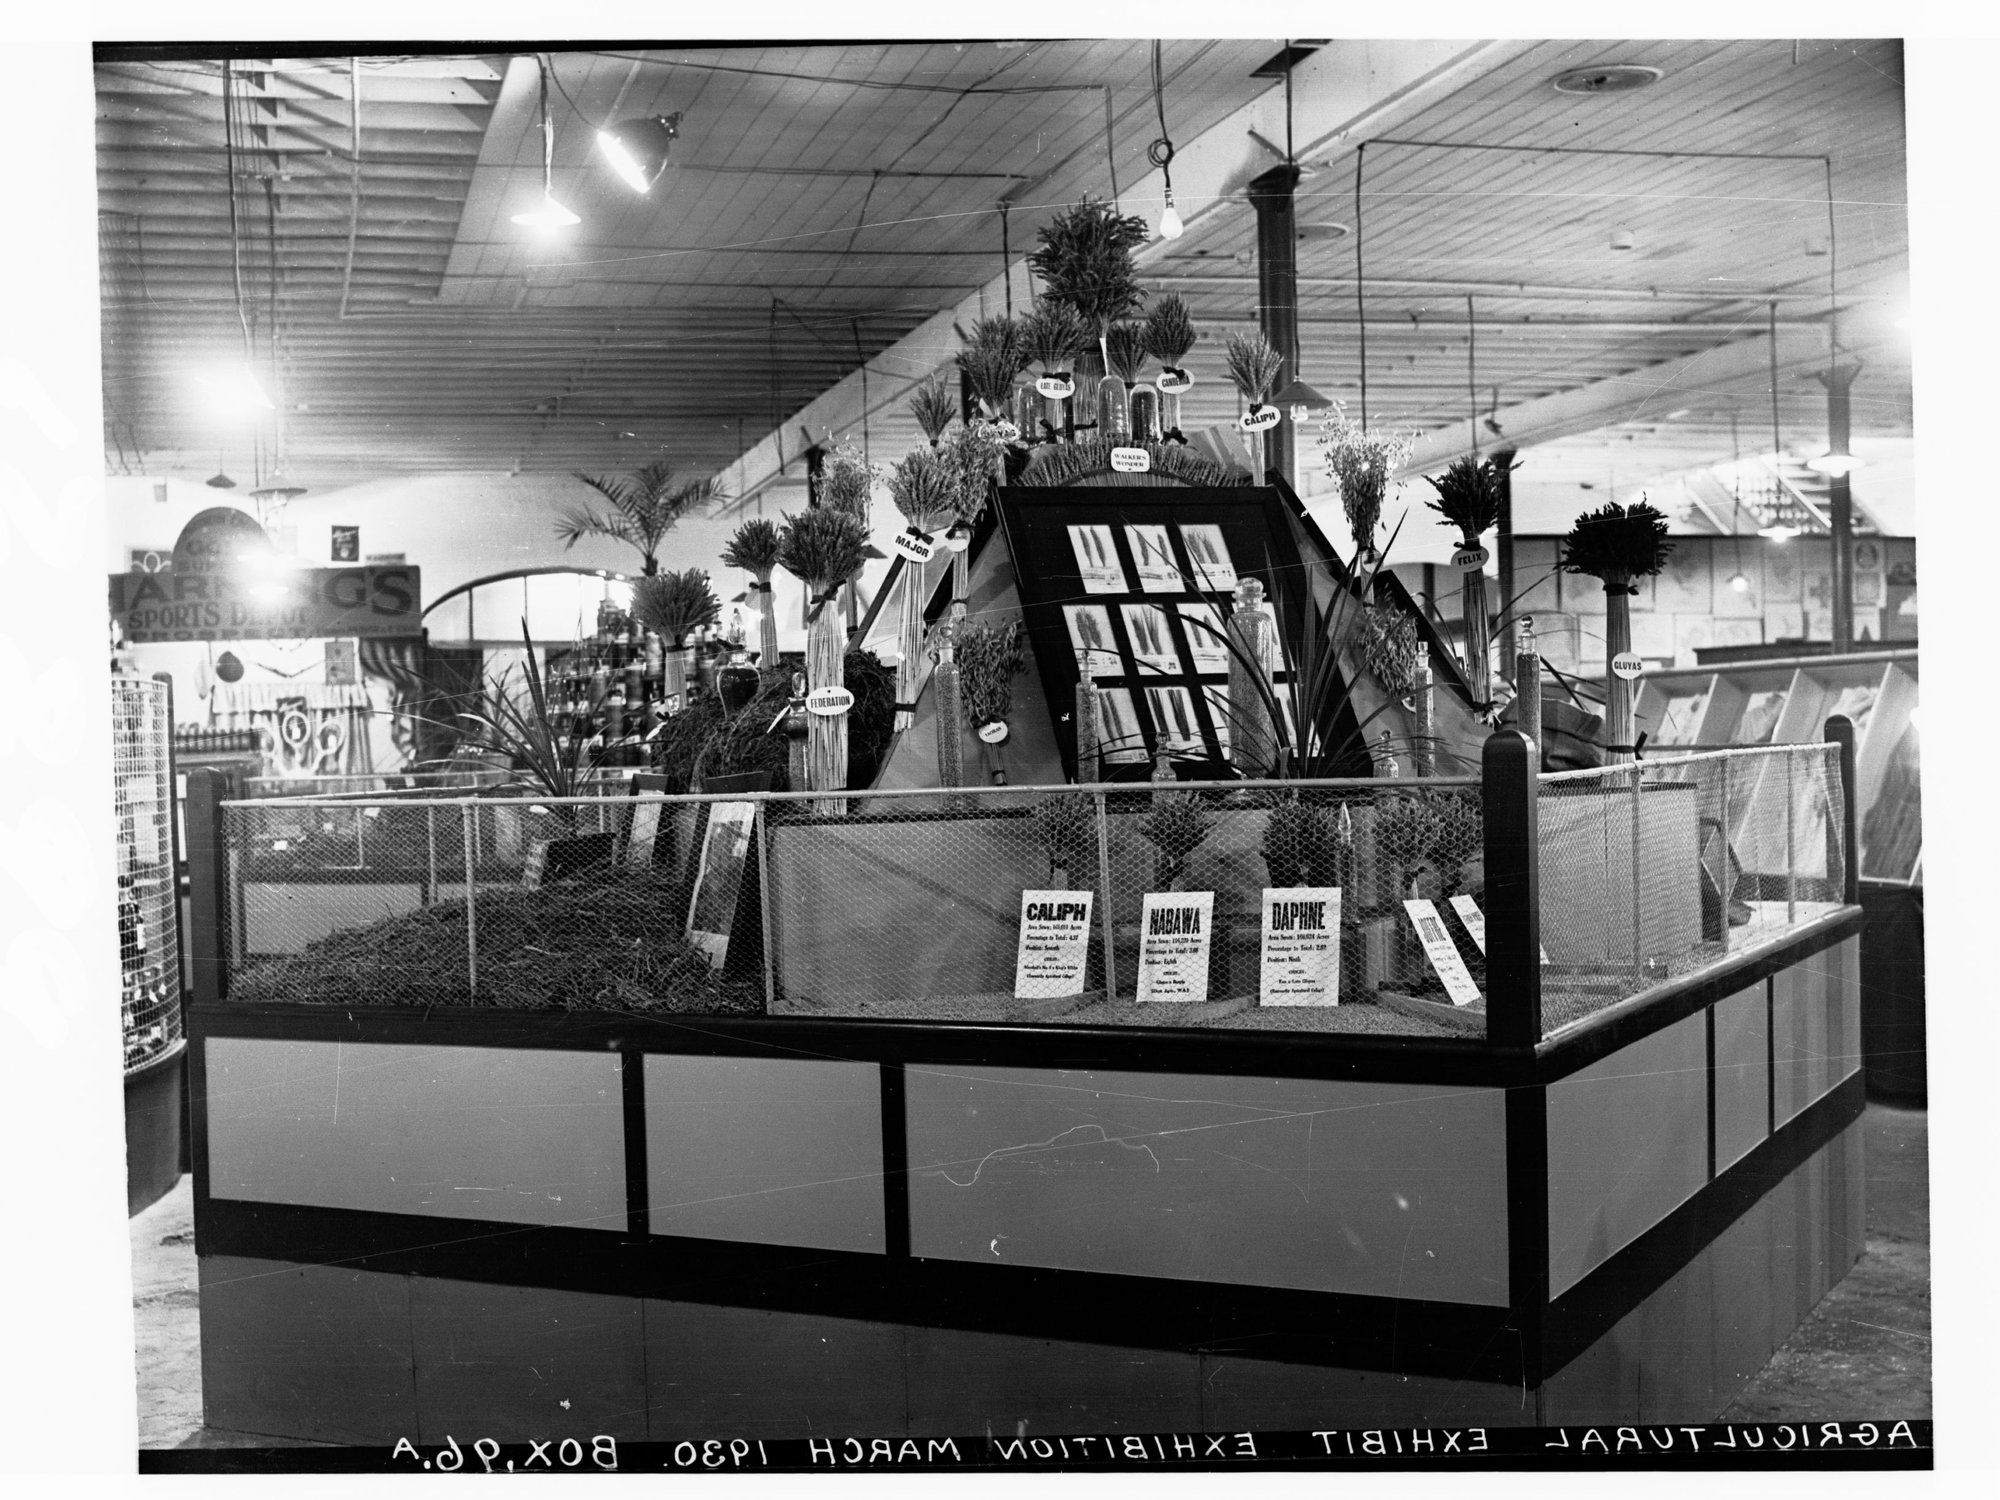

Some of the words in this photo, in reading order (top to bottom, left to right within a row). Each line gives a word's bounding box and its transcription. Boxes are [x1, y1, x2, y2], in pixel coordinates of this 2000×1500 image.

[1244, 412, 1276, 426] CALIPH
[895, 535, 929, 558] MAJOR
[1457, 552, 1482, 566] FELIX
[129, 602, 221, 630] SPORTS
[1614, 661, 1642, 671] GLUYAS
[810, 695, 850, 709] FEDERATION
[1026, 902, 1087, 921] CALIPH
[1149, 907, 1200, 935] NABAWA
[1272, 901, 1326, 930] DAPHNE
